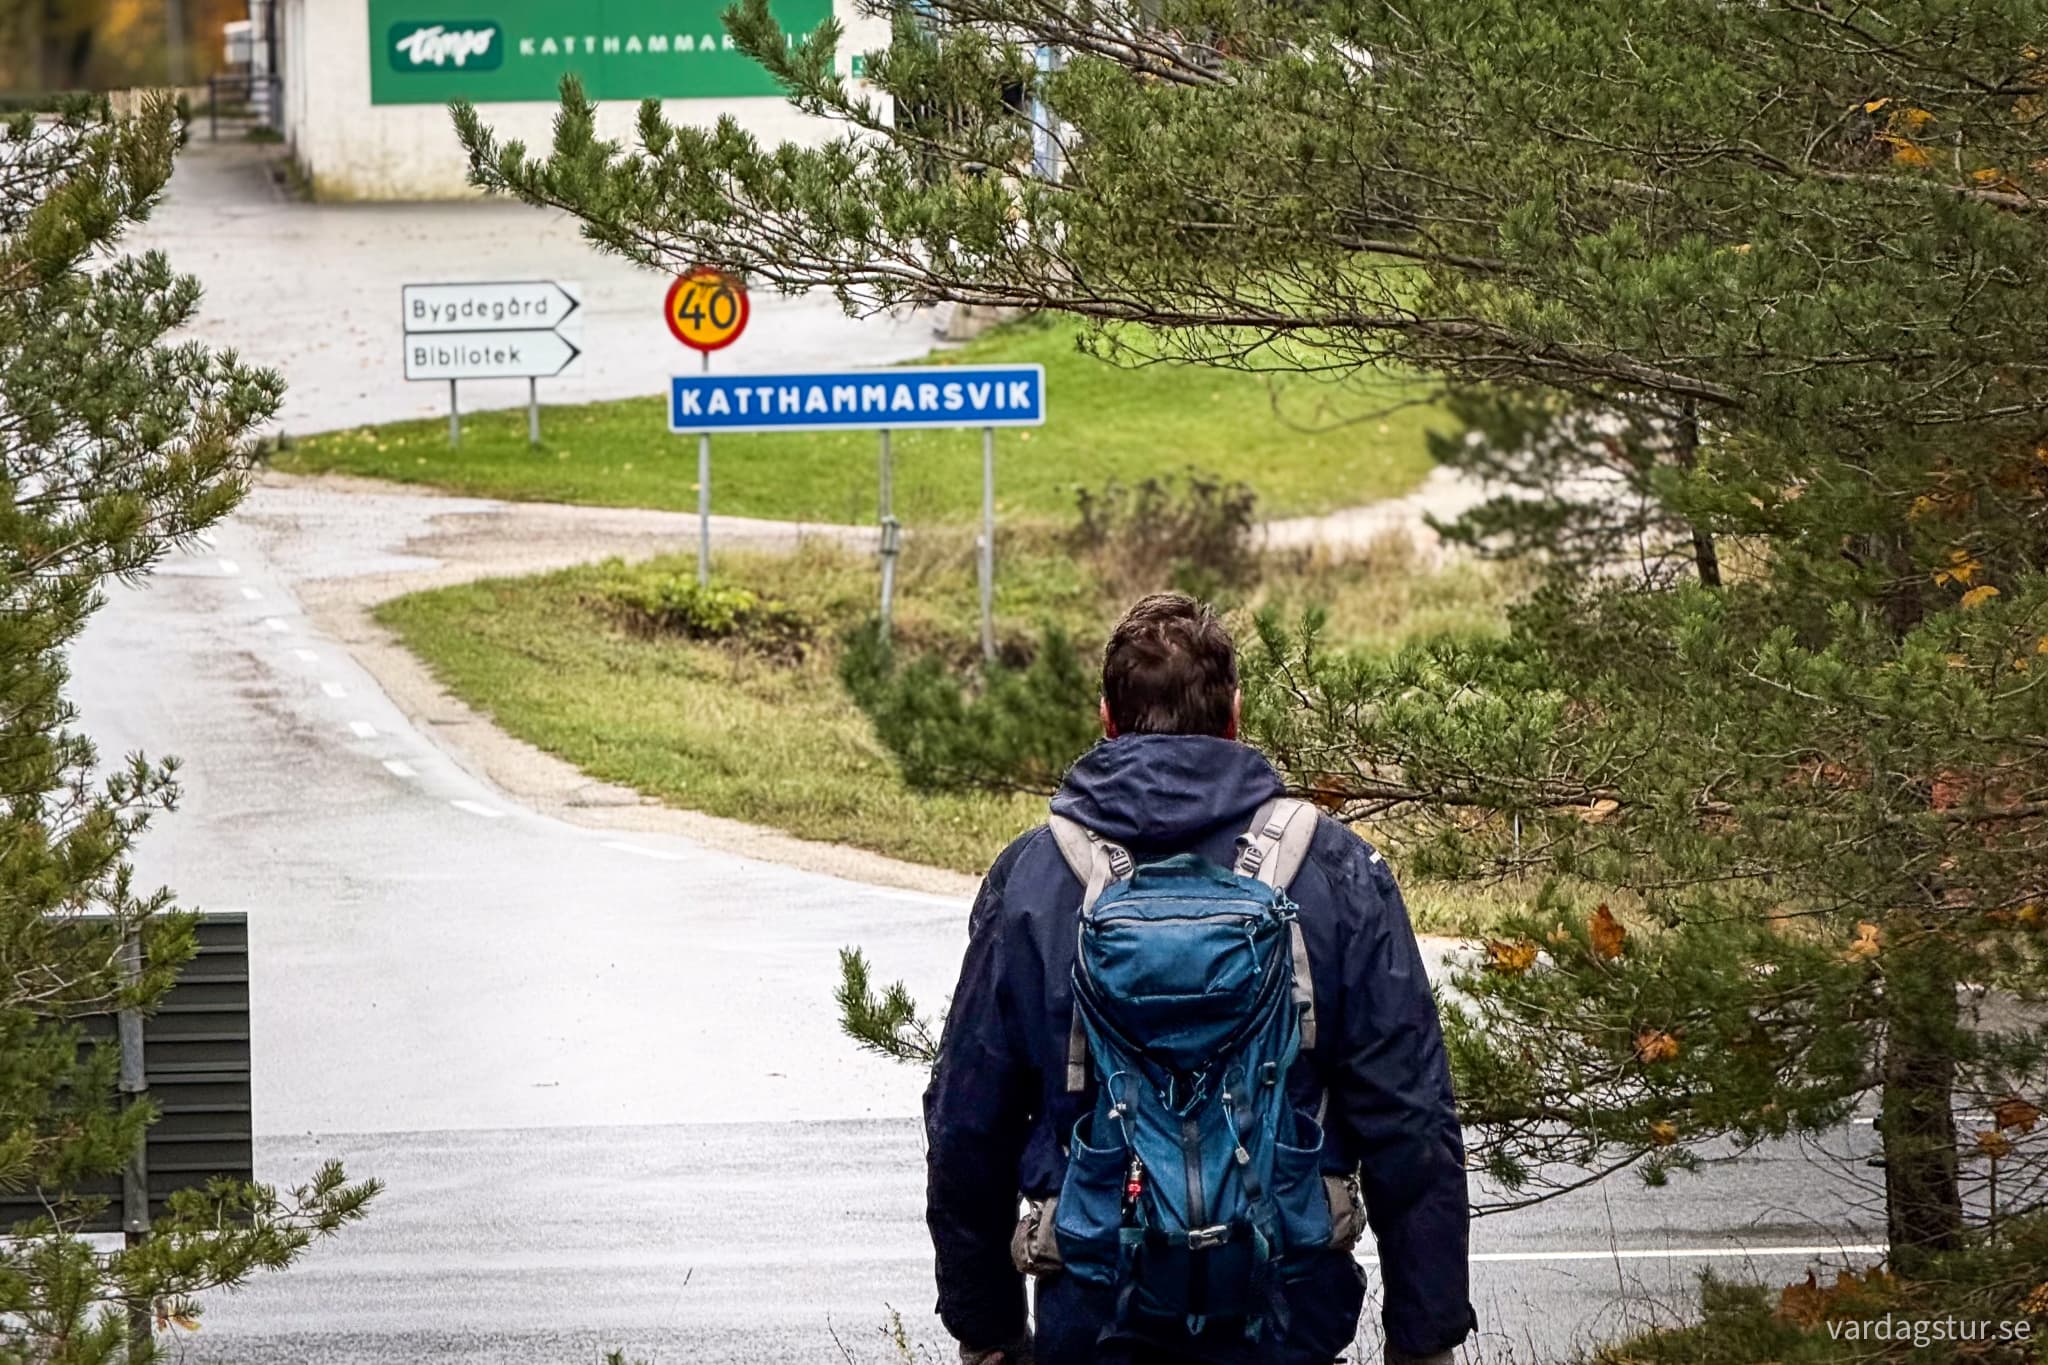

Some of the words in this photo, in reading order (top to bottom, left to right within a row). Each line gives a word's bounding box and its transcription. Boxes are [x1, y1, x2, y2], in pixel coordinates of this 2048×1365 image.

[519, 32, 816, 55] KATTHAMMARI
[412, 296, 548, 322] Bygdegård
[678, 287, 737, 330] 40
[414, 345, 521, 366] Bibliotek
[681, 381, 1032, 416] KATTHAMMARSVIK
